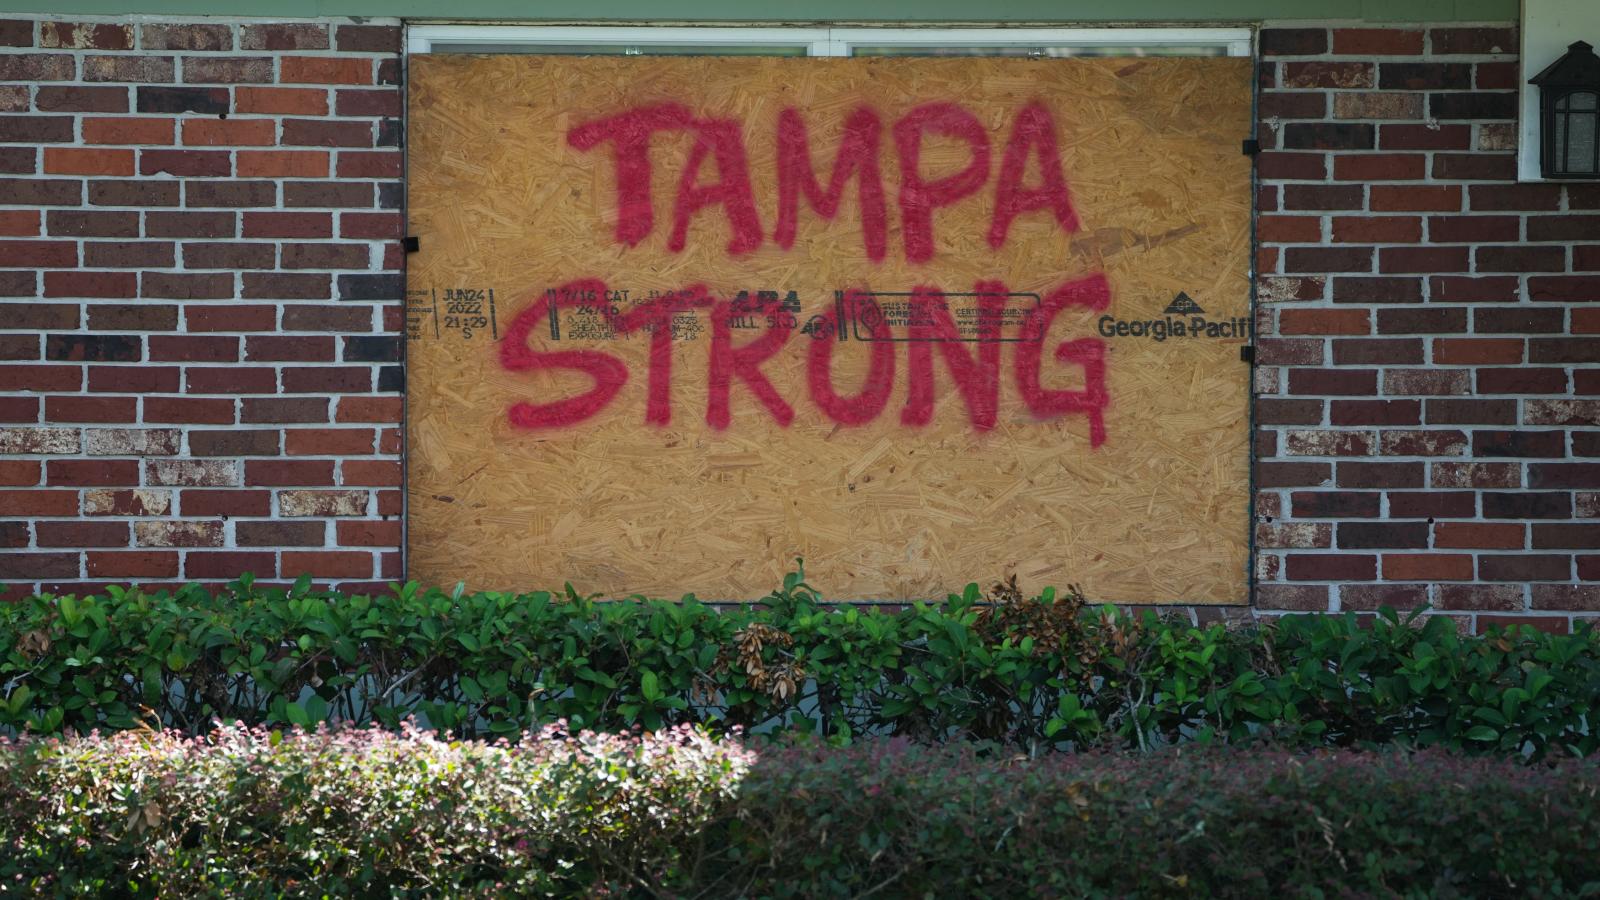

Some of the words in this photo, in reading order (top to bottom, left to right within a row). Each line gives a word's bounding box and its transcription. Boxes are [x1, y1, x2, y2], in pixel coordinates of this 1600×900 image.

[566, 100, 1081, 263] TAMPA
[443, 288, 485, 301] JUN24
[604, 289, 629, 302] CAT
[447, 302, 482, 314] 2022
[444, 316, 488, 328] 21:29
[462, 327, 474, 340] S
[497, 271, 1112, 448] STRONG
